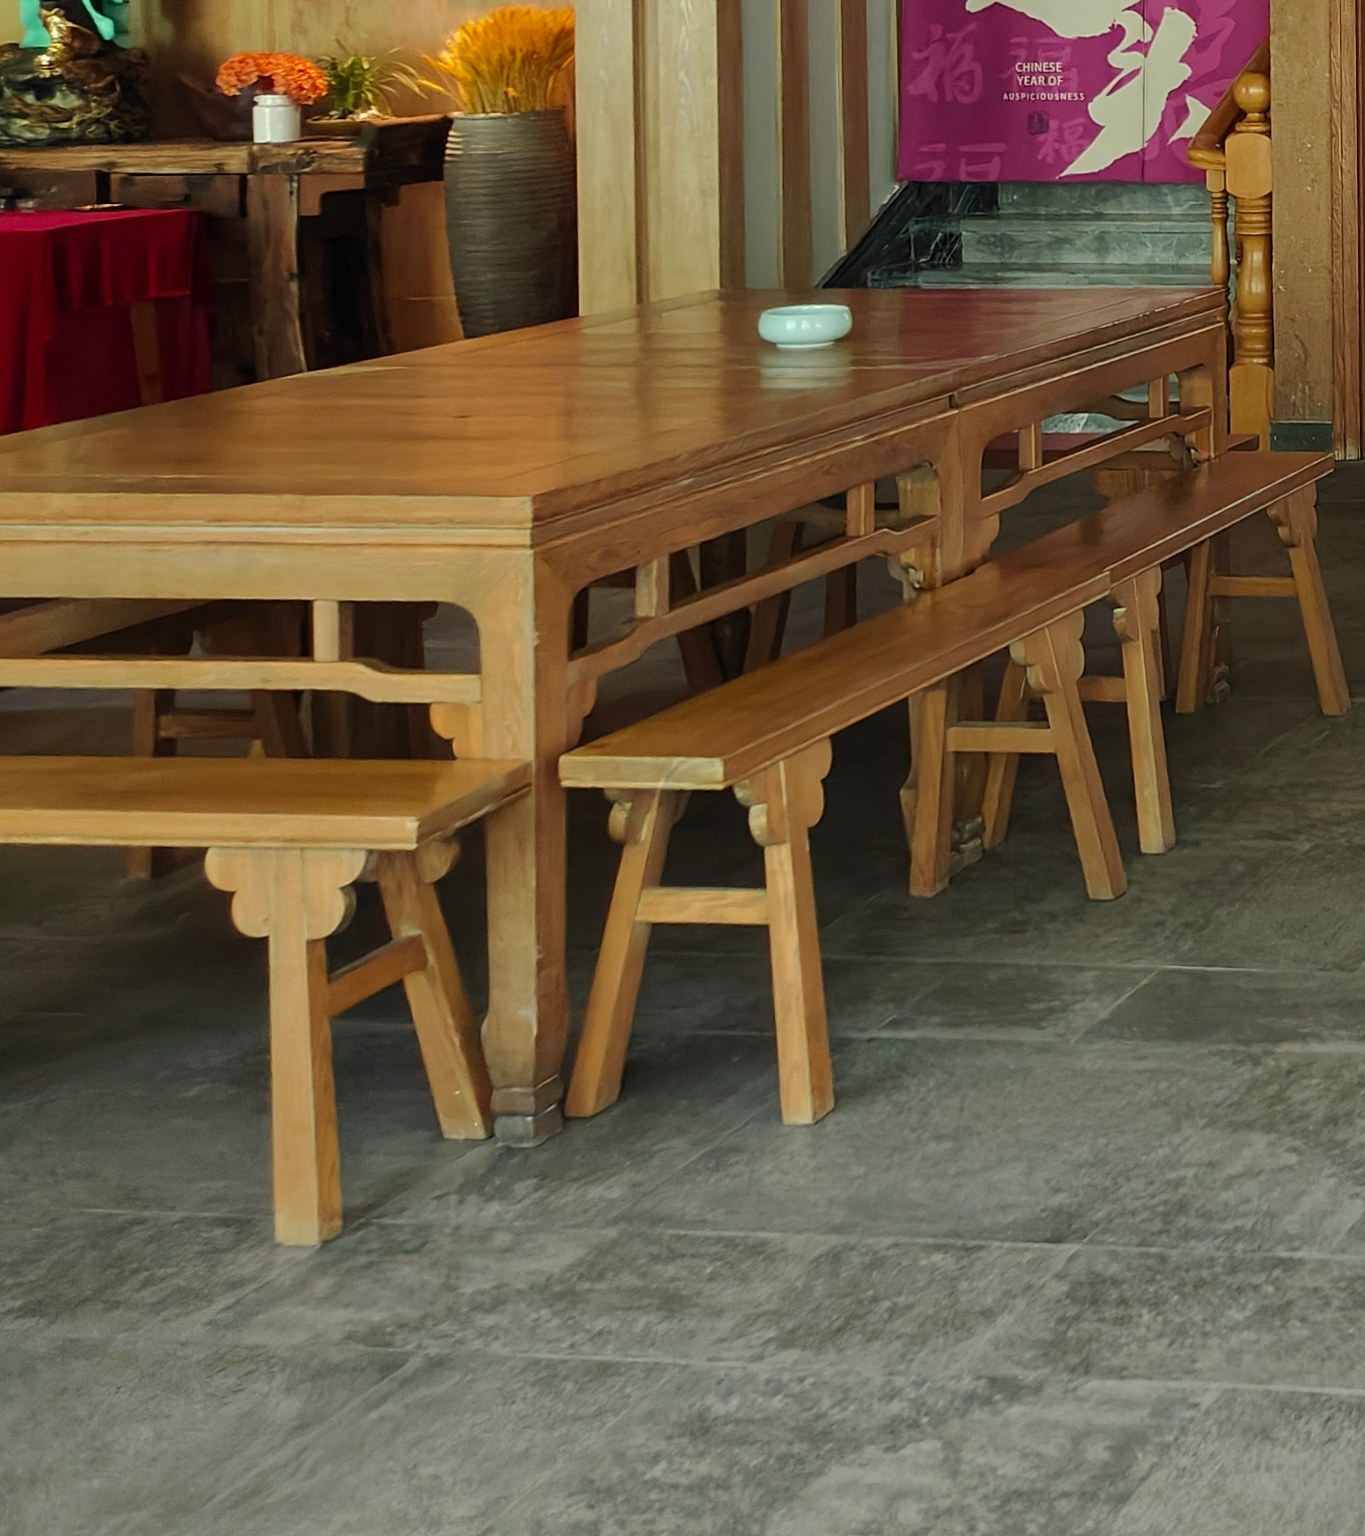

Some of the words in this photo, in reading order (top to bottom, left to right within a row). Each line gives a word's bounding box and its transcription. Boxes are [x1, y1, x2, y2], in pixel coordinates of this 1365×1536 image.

[1015, 61, 1063, 73] CHINESE
[1017, 75, 1046, 86] YEAR
[1047, 75, 1063, 86] OF
[1002, 92, 1085, 101] AUSPICIOUSNESS
